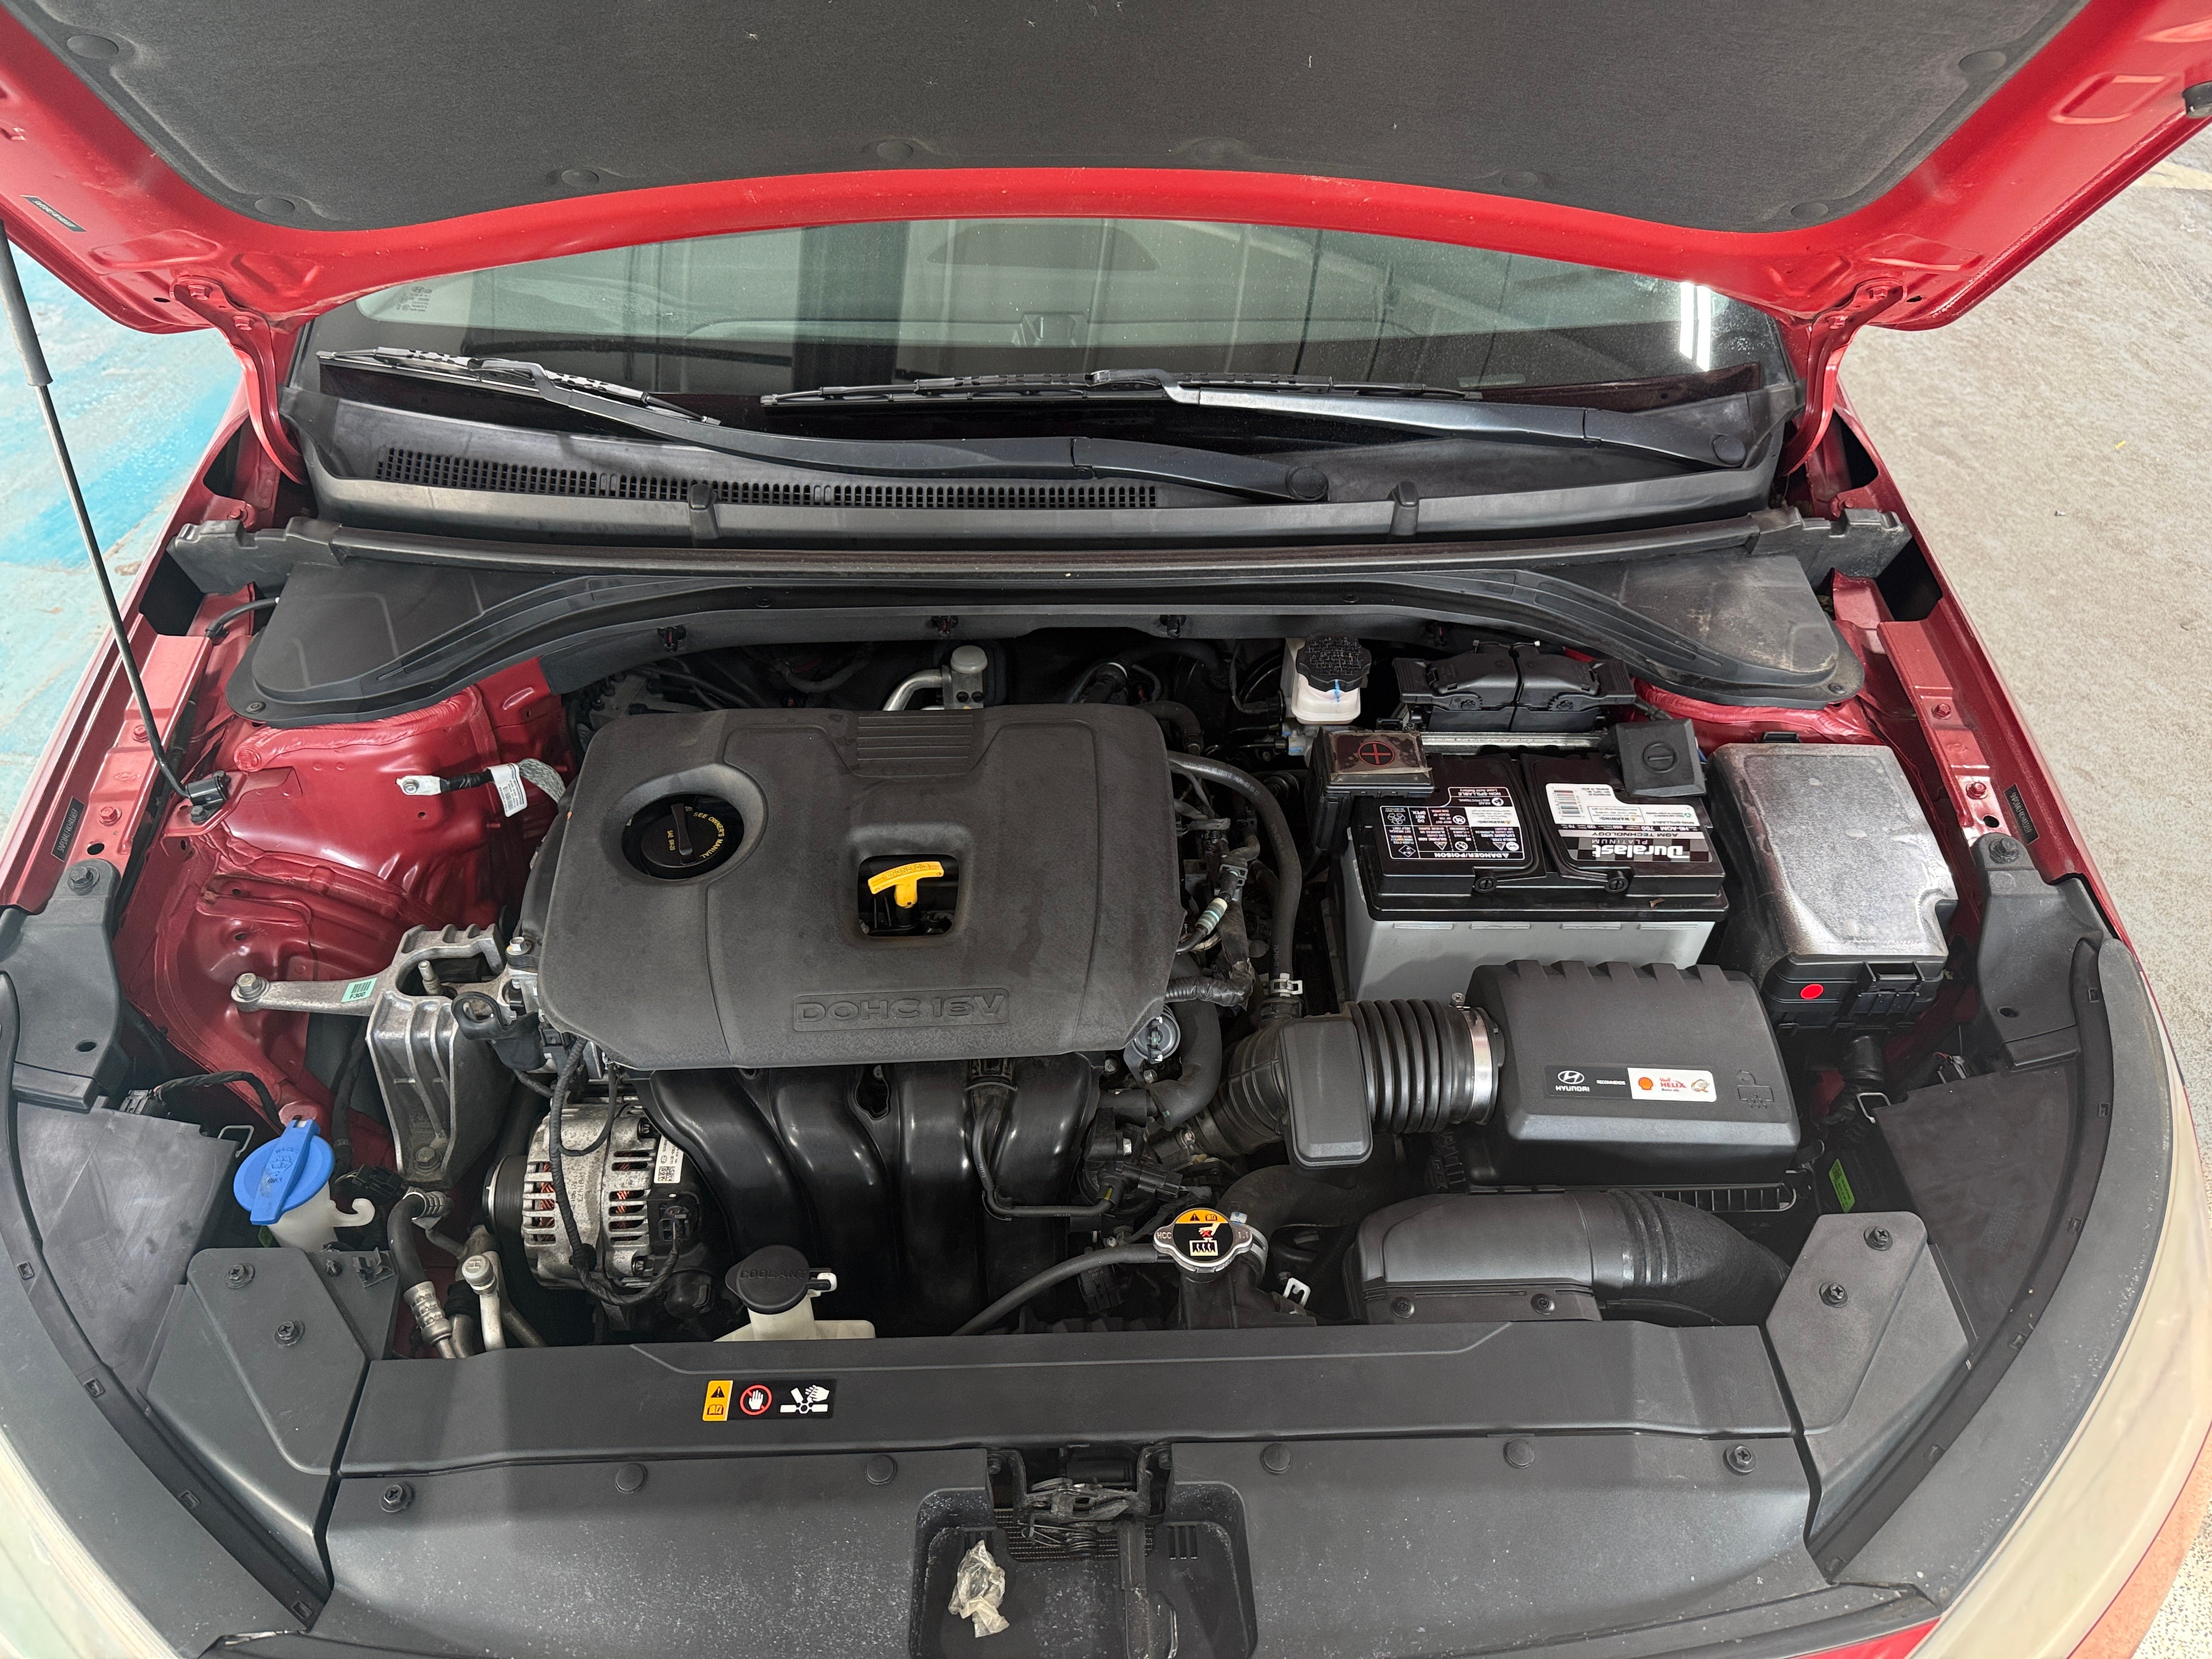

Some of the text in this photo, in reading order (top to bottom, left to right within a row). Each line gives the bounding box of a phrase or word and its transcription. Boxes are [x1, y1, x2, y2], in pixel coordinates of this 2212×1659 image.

[708, 816, 725, 837] OWNER'S
[698, 838, 723, 859] MANUAL
[1592, 845, 1690, 859] Duralast
[887, 866, 911, 878] ENGINE
[796, 995, 1004, 1023] DOHC 16V
[1555, 1085, 1590, 1093] HYUNDAI
[1660, 1080, 1686, 1088] HELIX
[1156, 1231, 1248, 1239] HCC 1.1
[740, 1269, 806, 1280] COOLANT
